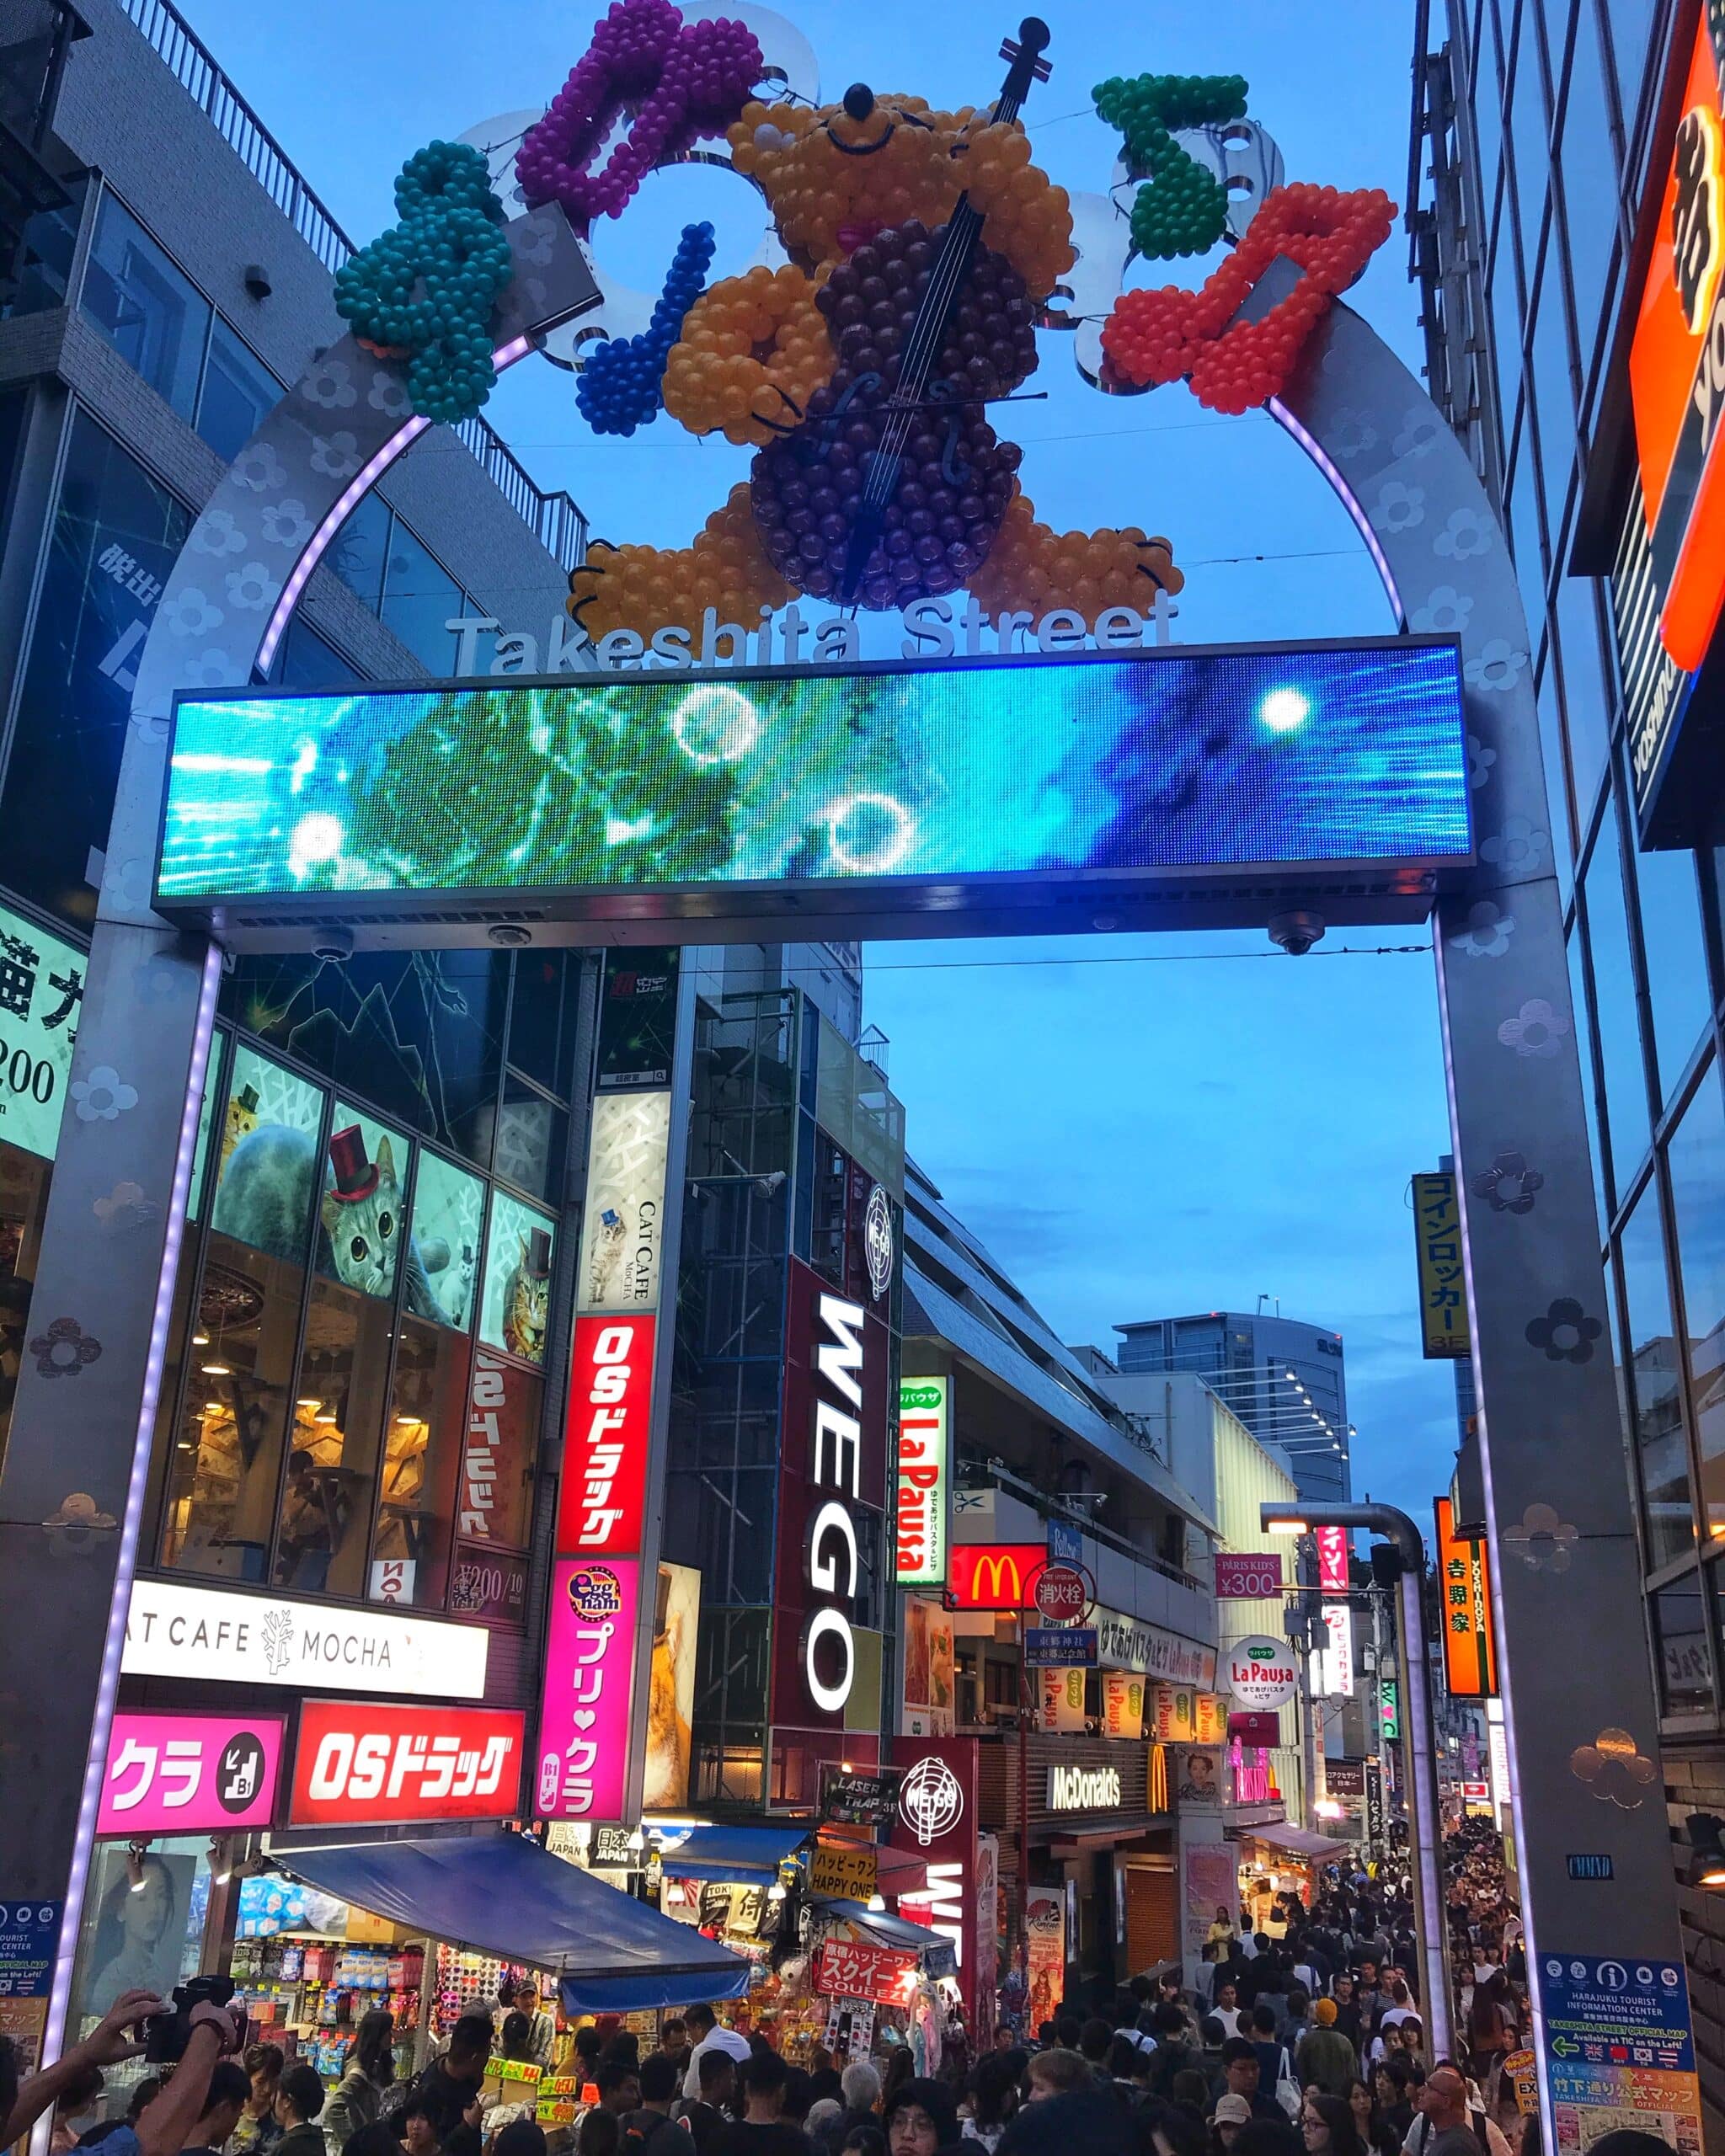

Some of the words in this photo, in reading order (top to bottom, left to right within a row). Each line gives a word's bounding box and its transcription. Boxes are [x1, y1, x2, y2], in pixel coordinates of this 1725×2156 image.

[444, 603, 861, 679] Takeshita
[902, 588, 1182, 662] Street
[638, 1201, 656, 1243] CAT
[1422, 1178, 1461, 1331] コインロッカー
[634, 1246, 653, 1300] CAFE
[1430, 1336, 1467, 1348] 3F
[578, 1326, 634, 1545] OSドラッグ
[899, 1418, 939, 1460] La
[806, 1290, 864, 1712] WEGO
[897, 1465, 939, 1572] Pausa
[1222, 1560, 1248, 1571] PARIS
[1250, 1560, 1274, 1571] KID'S
[569, 1573, 613, 1598] egg
[1039, 1583, 1081, 1604] 消火栓
[1220, 1573, 1274, 1596] ¥300
[1447, 1558, 1470, 1632] 吉野家
[1471, 1560, 1485, 1632] YOSHINOYA
[169, 1616, 249, 1652] CAFE
[302, 1630, 392, 1668] MOCHA
[1108, 1678, 1124, 1693] La
[1232, 1662, 1248, 1682] La
[1250, 1662, 1294, 1684] Pausa
[1108, 1695, 1124, 1733] Pausa
[308, 1732, 513, 1801] OSドラッグ
[837, 1777, 880, 1794] LASER
[1053, 1766, 1120, 1810] McDonald's
[845, 1795, 880, 1809] TRAP
[551, 1842, 581, 1856] JAPAN
[597, 1828, 630, 1850] 日本
[596, 1849, 628, 1863] JAPAN
[816, 1854, 877, 1876] ハッピーワン
[812, 1873, 847, 1892] HAPPY
[850, 1881, 873, 1900] ONE
[825, 1943, 916, 1970] 原宿ハッピーワン
[1567, 2001, 1628, 2014] INFORMATION
[1630, 2005, 1663, 2016] CENTER
[1572, 1992, 1617, 2004] HARAJUKU
[1621, 1995, 1657, 2006] TOURIST
[1548, 2019, 1594, 2031] TAKESHITA
[1595, 2022, 1627, 2035] STREET
[1628, 2025, 1665, 2037] OFFICIAL
[1667, 2029, 1687, 2039] MAP
[1573, 2033, 1609, 2043] Available
[1621, 2036, 1634, 2046] TIC
[1647, 2039, 1661, 2047] the
